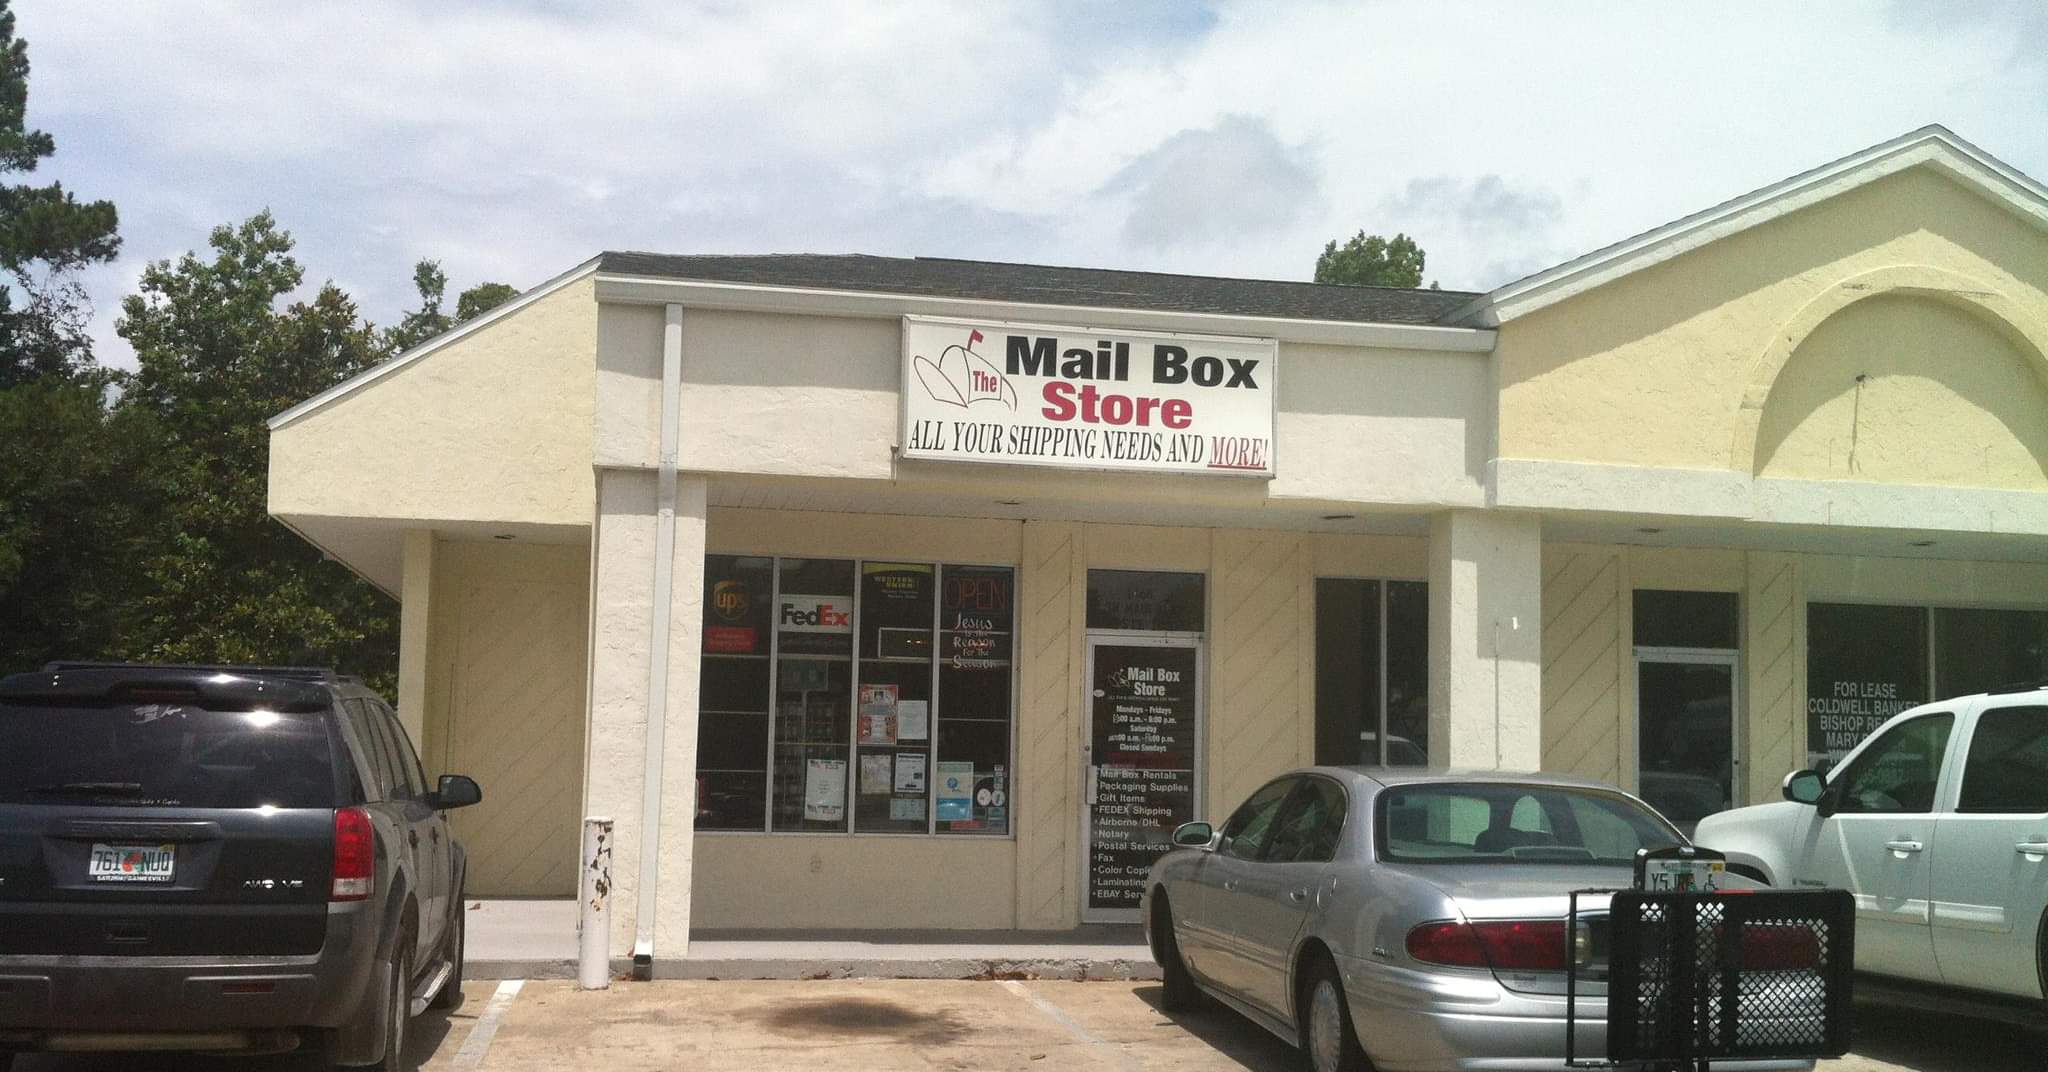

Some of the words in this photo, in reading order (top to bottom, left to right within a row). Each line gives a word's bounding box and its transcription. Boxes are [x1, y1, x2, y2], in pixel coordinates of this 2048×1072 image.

[1006, 335, 1129, 382] Mail
[1153, 344, 1260, 390] Box
[973, 370, 997, 392] The
[1042, 381, 1192, 429] Store
[909, 420, 946, 451] ALL
[952, 422, 1004, 454] YOUR
[1007, 425, 1096, 459] SHIPPING
[1101, 430, 1162, 463] NEEDS
[1166, 434, 1204, 464] AND
[1209, 436, 1268, 469] MORE!
[944, 576, 1008, 609] OPEN
[781, 603, 849, 626] FedEx
[955, 612, 992, 630] Jesus
[1127, 667, 1154, 682] Mail
[1157, 668, 1180, 682] Box
[1134, 681, 1166, 696] Store
[1834, 682, 1858, 698] FOR
[1860, 683, 1897, 698] LEASE
[1808, 698, 1872, 715] COLDWELL
[1820, 716, 1864, 731] BISHOP
[1826, 732, 1859, 748] MARY
[1100, 769, 1120, 779] Mail
[1122, 770, 1139, 779] Box
[1143, 771, 1177, 780] Rentals
[1100, 782, 1147, 793] Packaging
[1150, 783, 1188, 793] Supplies
[1100, 793, 1117, 802] Gift
[1120, 794, 1145, 802] Items
[1099, 805, 1129, 814] FEDEX
[1132, 806, 1172, 817] Shipping
[1099, 829, 1129, 840] Notary
[1098, 841, 1127, 850] Postal
[1130, 842, 1170, 851] Services
[94, 851, 120, 872] 761
[1098, 853, 1114, 862] Fax
[1098, 865, 1123, 874] Color
[243, 879, 275, 889] AWD
[1097, 889, 1121, 898] EBAY
[1124, 890, 1146, 899] Serv
